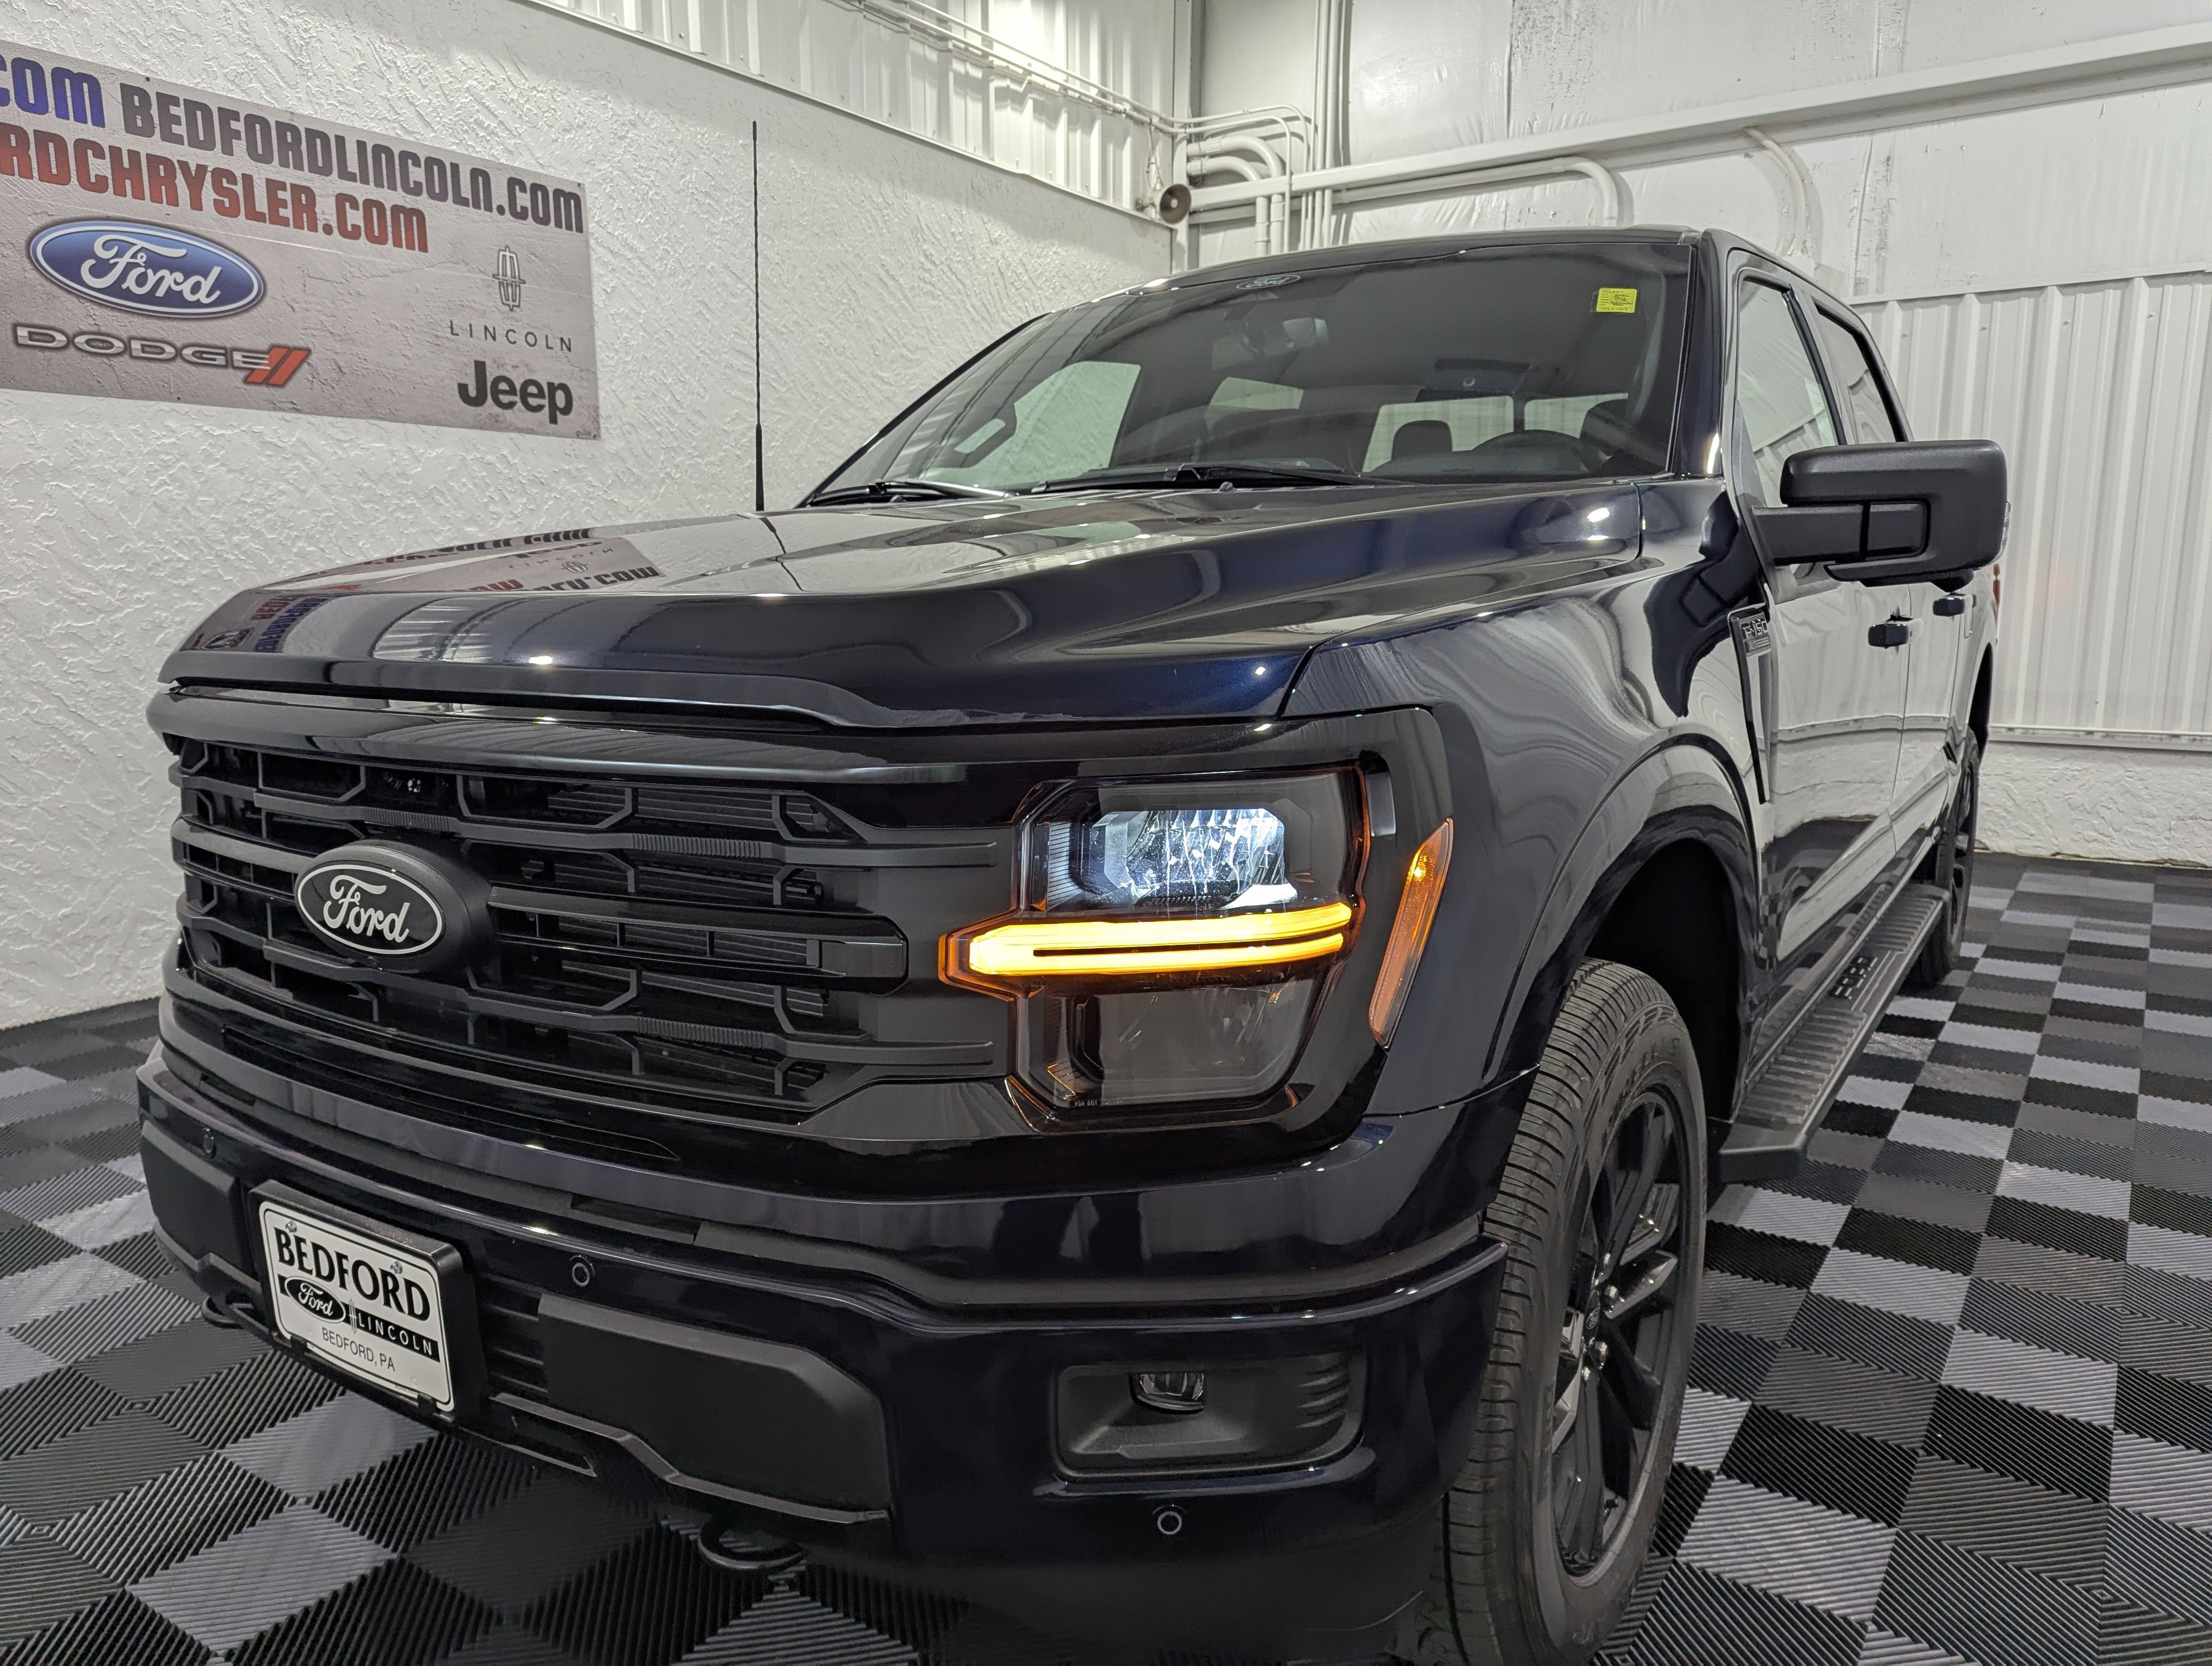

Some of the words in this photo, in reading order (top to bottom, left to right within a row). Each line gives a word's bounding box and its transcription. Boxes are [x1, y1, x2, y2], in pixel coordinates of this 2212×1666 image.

[0, 121, 428, 253] RDCHRYSLER.COM
[120, 82, 584, 234] BEDFORDLINCOLN.COM
[81, 234, 222, 304] Ford
[16, 325, 271, 370] DODGE
[449, 320, 571, 352] LINCOLN
[457, 360, 574, 425] Jeep
[324, 875, 410, 943] Ford
[273, 1227, 430, 1322] BEDFORD
[298, 1283, 333, 1316] Ford
[322, 1327, 378, 1367] BEDFORD,
[380, 1353, 396, 1372] PA
[358, 1312, 433, 1356] LINCOLN
